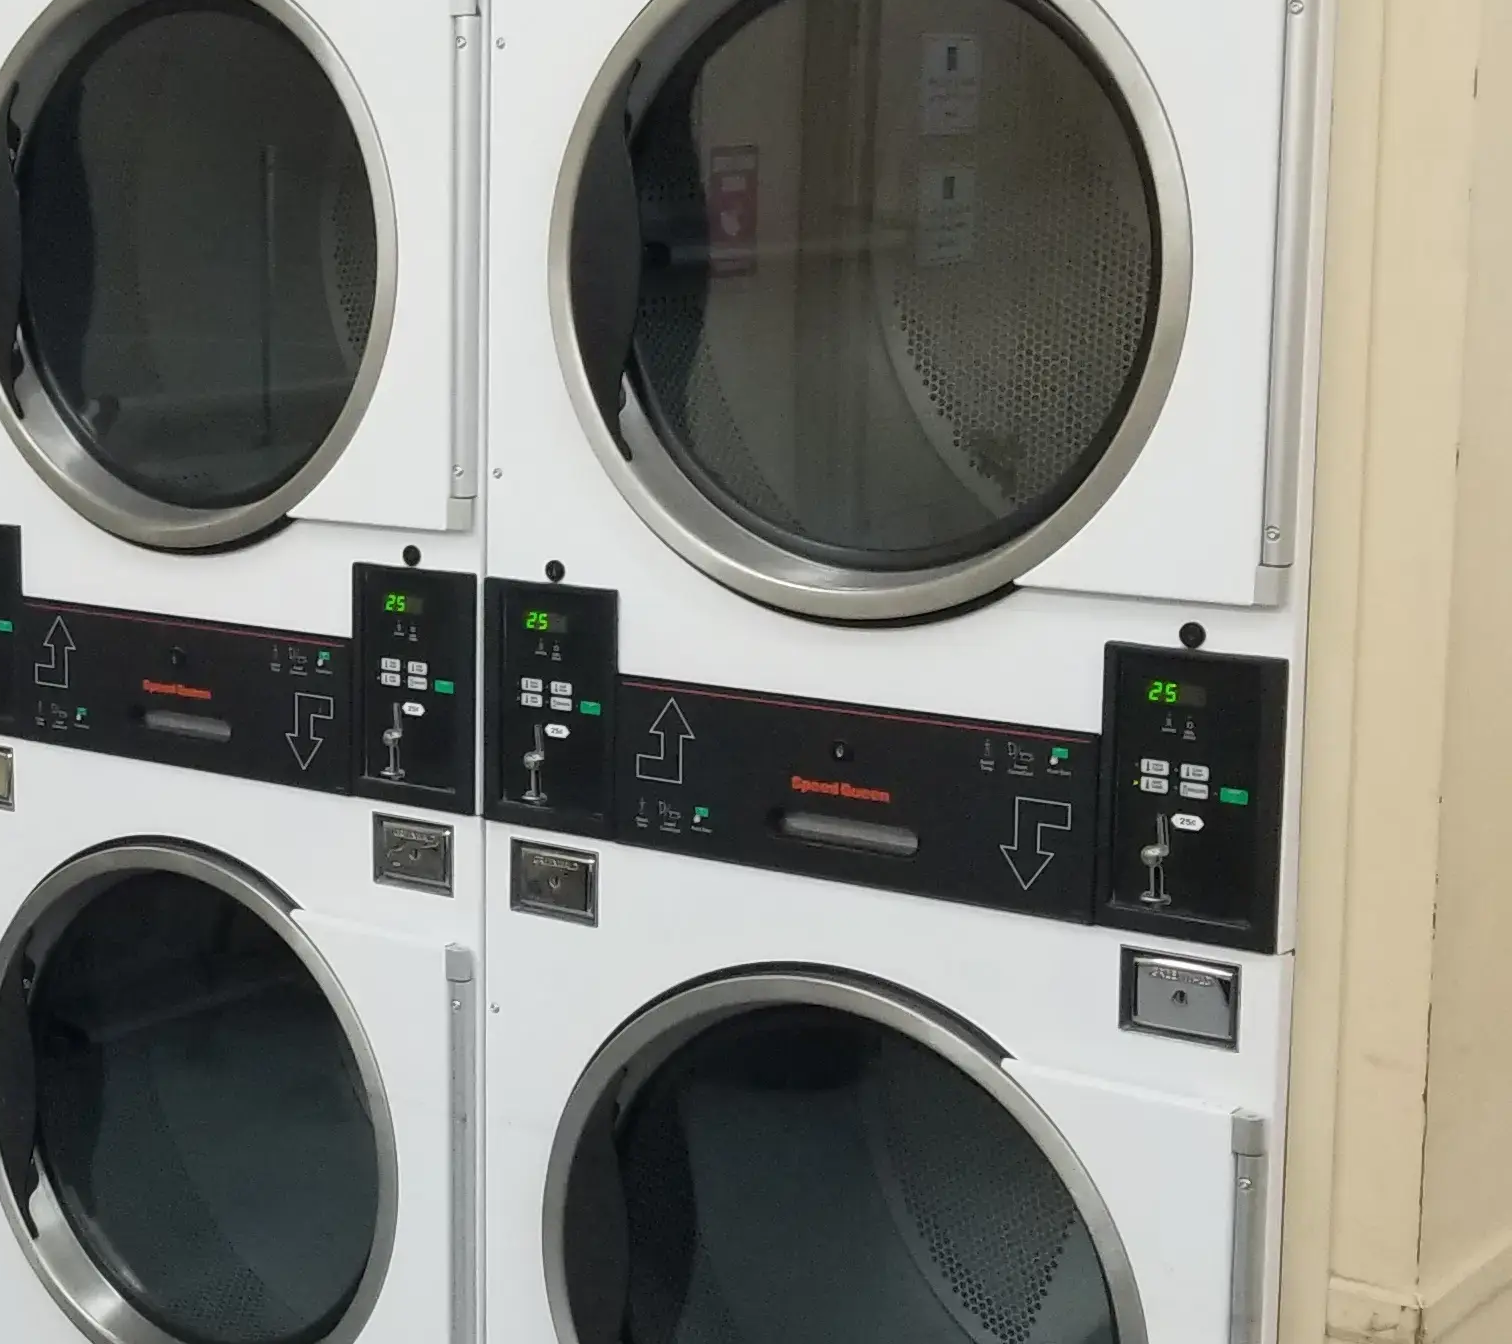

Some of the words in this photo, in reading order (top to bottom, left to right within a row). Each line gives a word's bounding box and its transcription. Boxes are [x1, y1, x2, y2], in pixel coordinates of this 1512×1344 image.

[385, 594, 405, 612] 25
[526, 612, 548, 630] 25
[1149, 681, 1177, 702] 25
